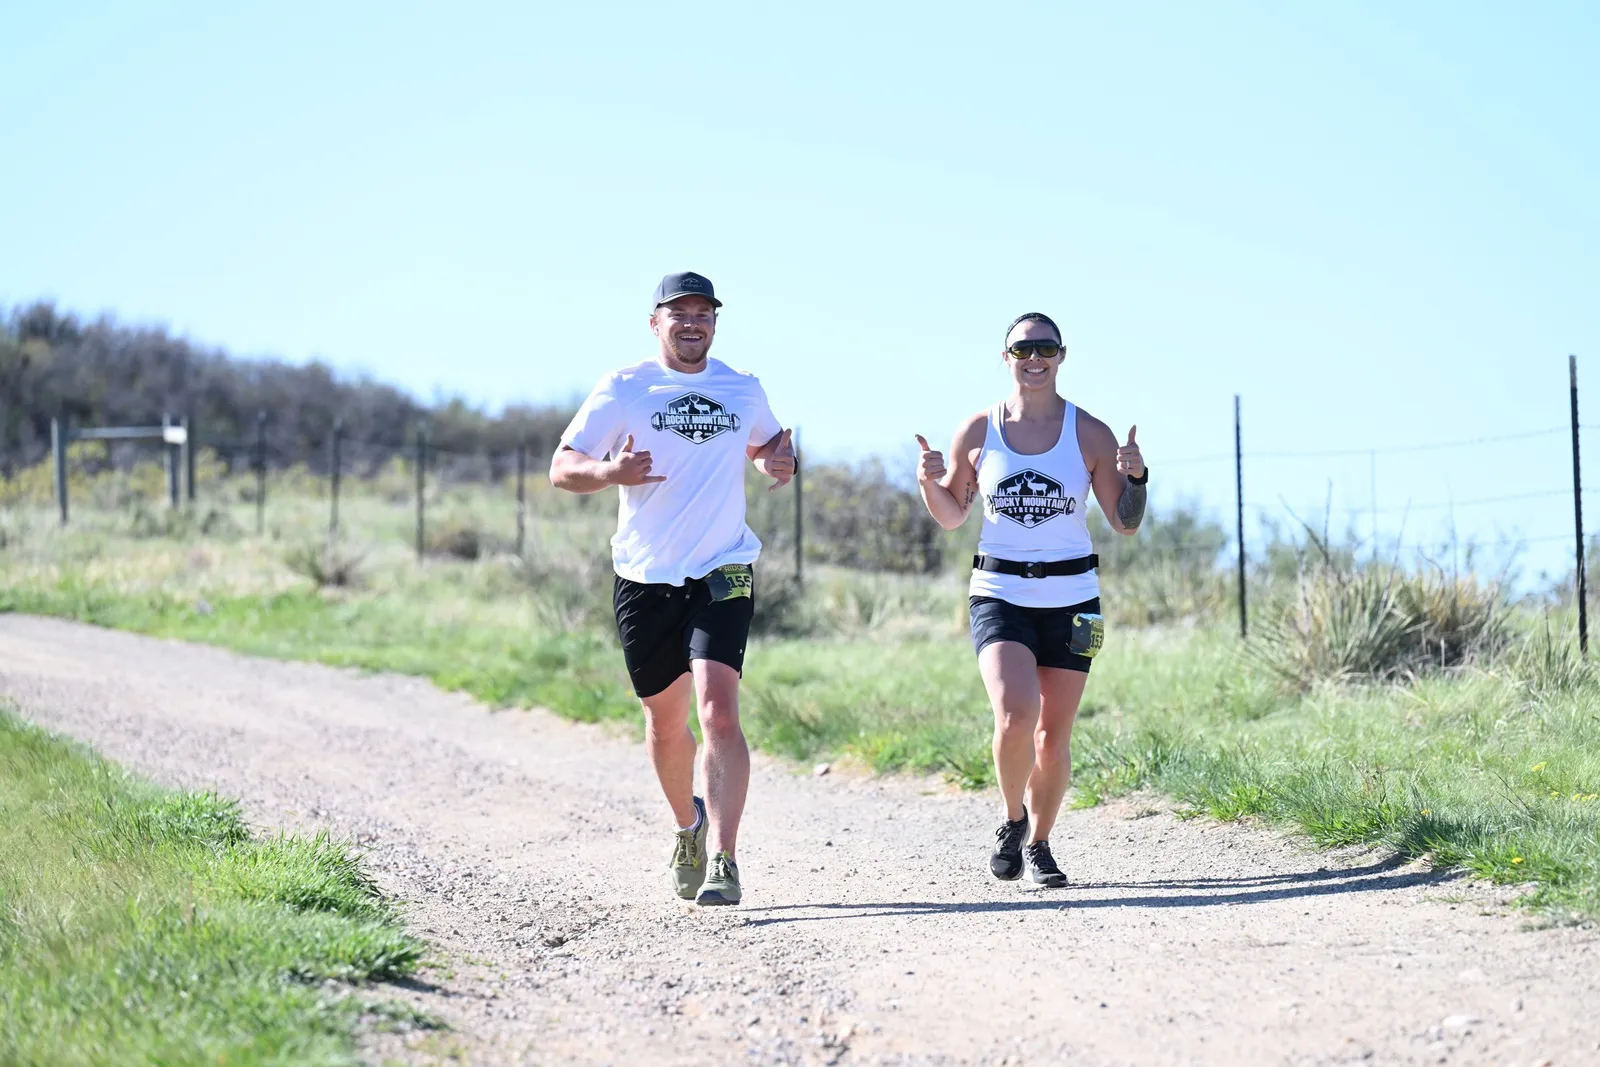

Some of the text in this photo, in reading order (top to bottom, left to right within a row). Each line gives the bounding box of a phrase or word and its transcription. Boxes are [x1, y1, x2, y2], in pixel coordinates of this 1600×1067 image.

[665, 415, 730, 426] ROCKY MOUNTAIN
[993, 497, 1067, 509] ROCKY MOUNTAIN
[726, 576, 750, 588] 155
